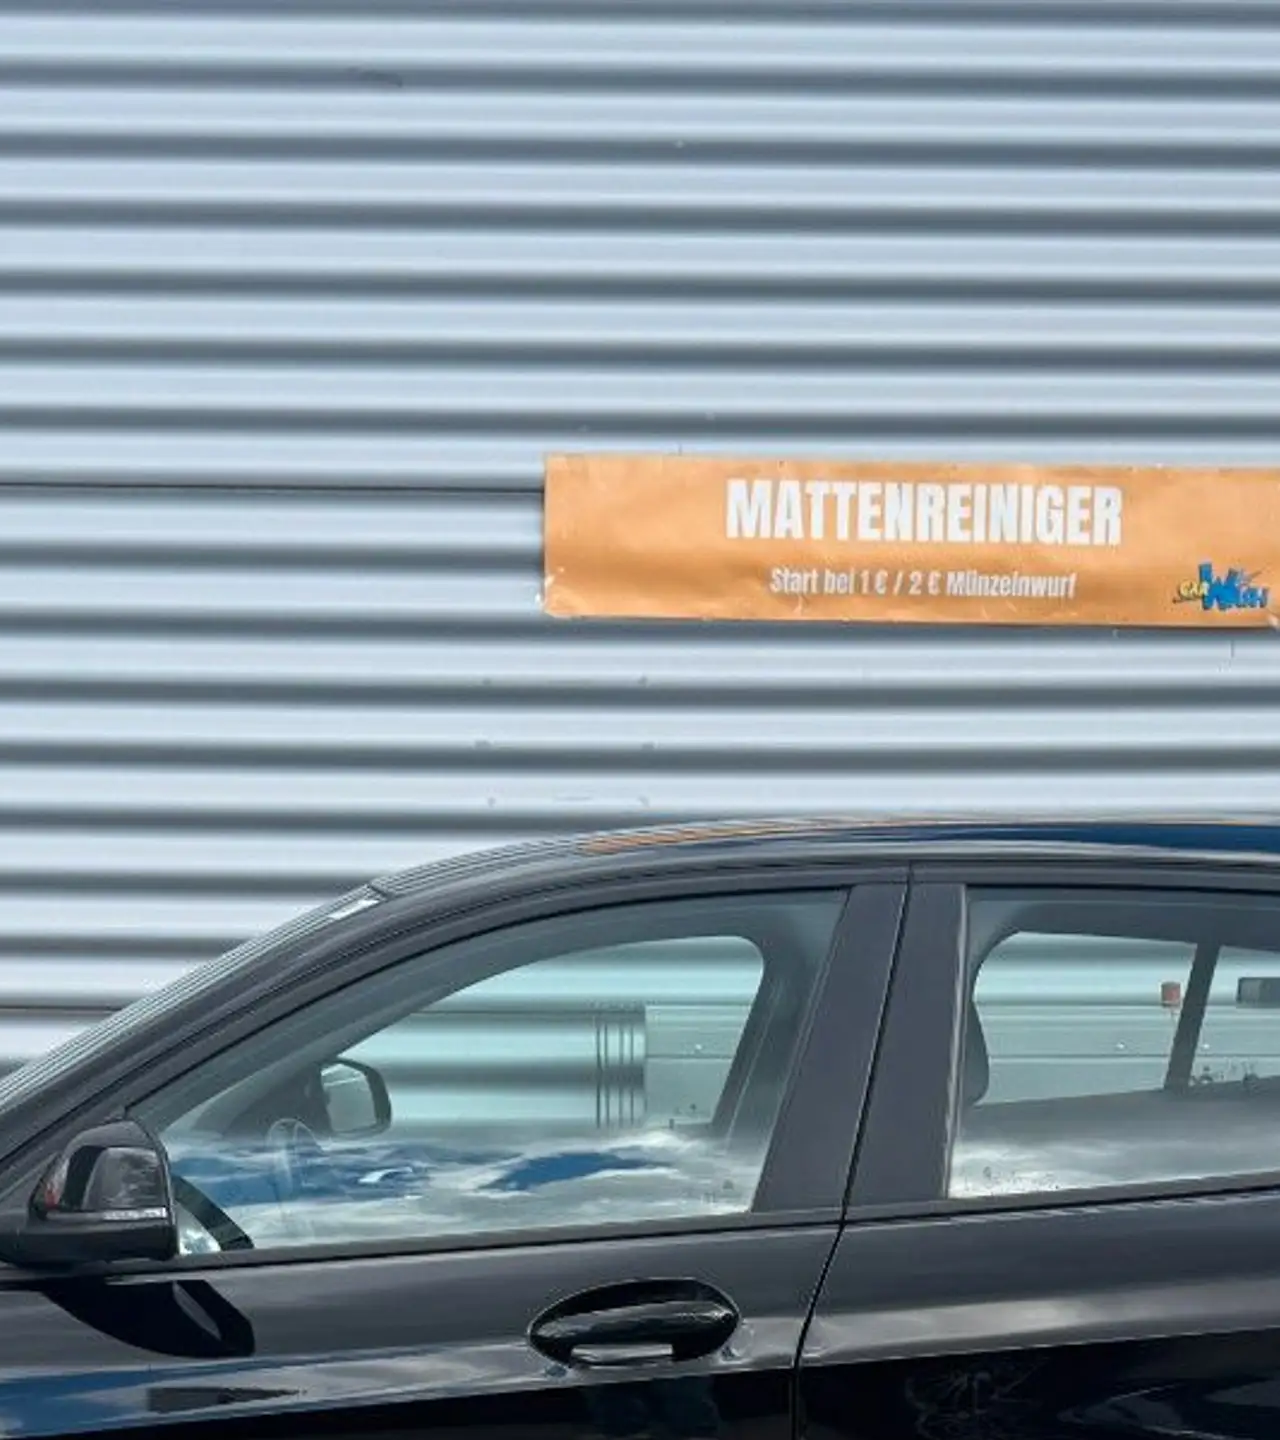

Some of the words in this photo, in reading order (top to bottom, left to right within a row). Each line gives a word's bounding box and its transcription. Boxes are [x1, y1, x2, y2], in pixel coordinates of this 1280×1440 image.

[726, 478, 1122, 546] MATTENREINIGER
[771, 566, 818, 594] Start
[824, 568, 855, 595] bei
[860, 570, 870, 595] 1
[875, 569, 888, 595] €
[892, 570, 903, 596] /
[908, 570, 922, 595] 2
[927, 570, 941, 595] €
[947, 569, 1078, 599] Münzeinwurf
